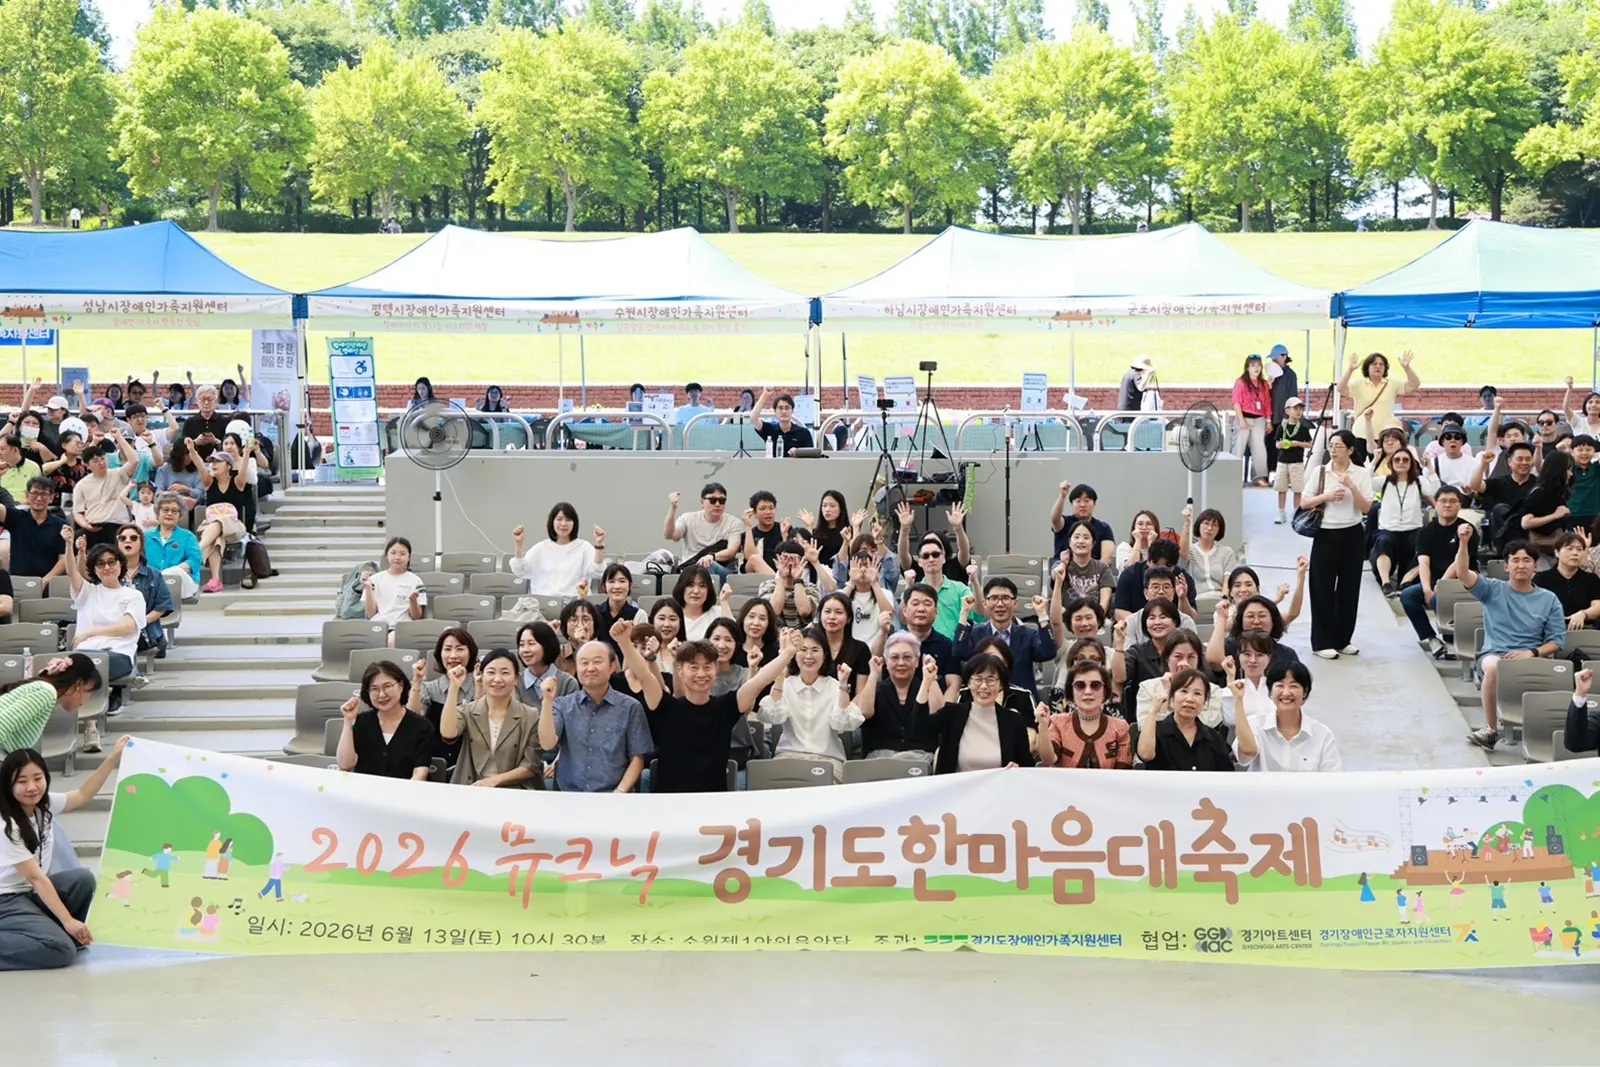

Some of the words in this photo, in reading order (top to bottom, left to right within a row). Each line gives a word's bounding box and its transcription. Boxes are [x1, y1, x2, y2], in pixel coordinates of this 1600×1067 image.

[82, 298, 228, 314] 성남시장애인가족지원센터
[371, 302, 505, 318] 평택시장애인가족지원센터
[614, 303, 748, 320] 수원시장애인가족지원센터
[883, 302, 1017, 318] 하남시장애인가족지원센터
[303, 827, 470, 887] 2026
[247, 916, 293, 936] 일시:
[300, 920, 374, 942] 2026년
[381, 926, 414, 944] 6월
[423, 928, 501, 946] 13일(토)
[511, 932, 554, 945] 10시
[1241, 929, 1312, 942] 경기아트센터
[1319, 926, 1451, 940] 경기장애인근로자지원센터
[971, 934, 1122, 947] 경기도장애인가족지원센터
